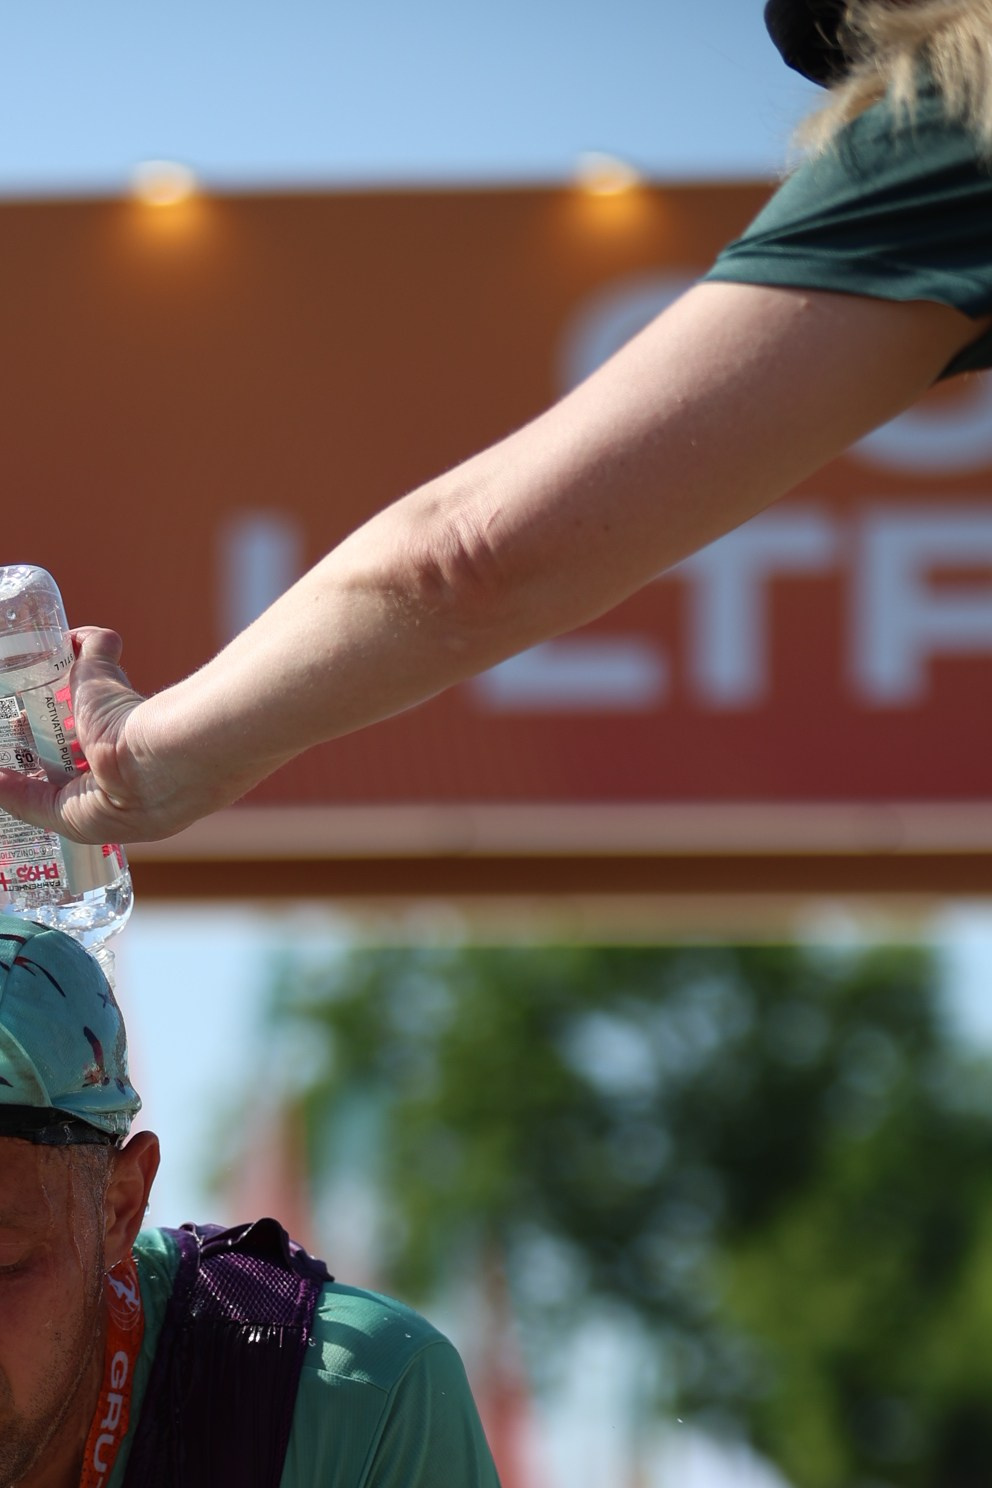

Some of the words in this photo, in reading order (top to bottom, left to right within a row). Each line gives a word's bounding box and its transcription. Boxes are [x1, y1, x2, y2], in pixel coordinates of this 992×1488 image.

[54, 654, 74, 671] STILL
[45, 696, 66, 746] ACTIVATED
[59, 747, 74, 772] PURE
[8, 880, 60, 891] FAHRENHEIT
